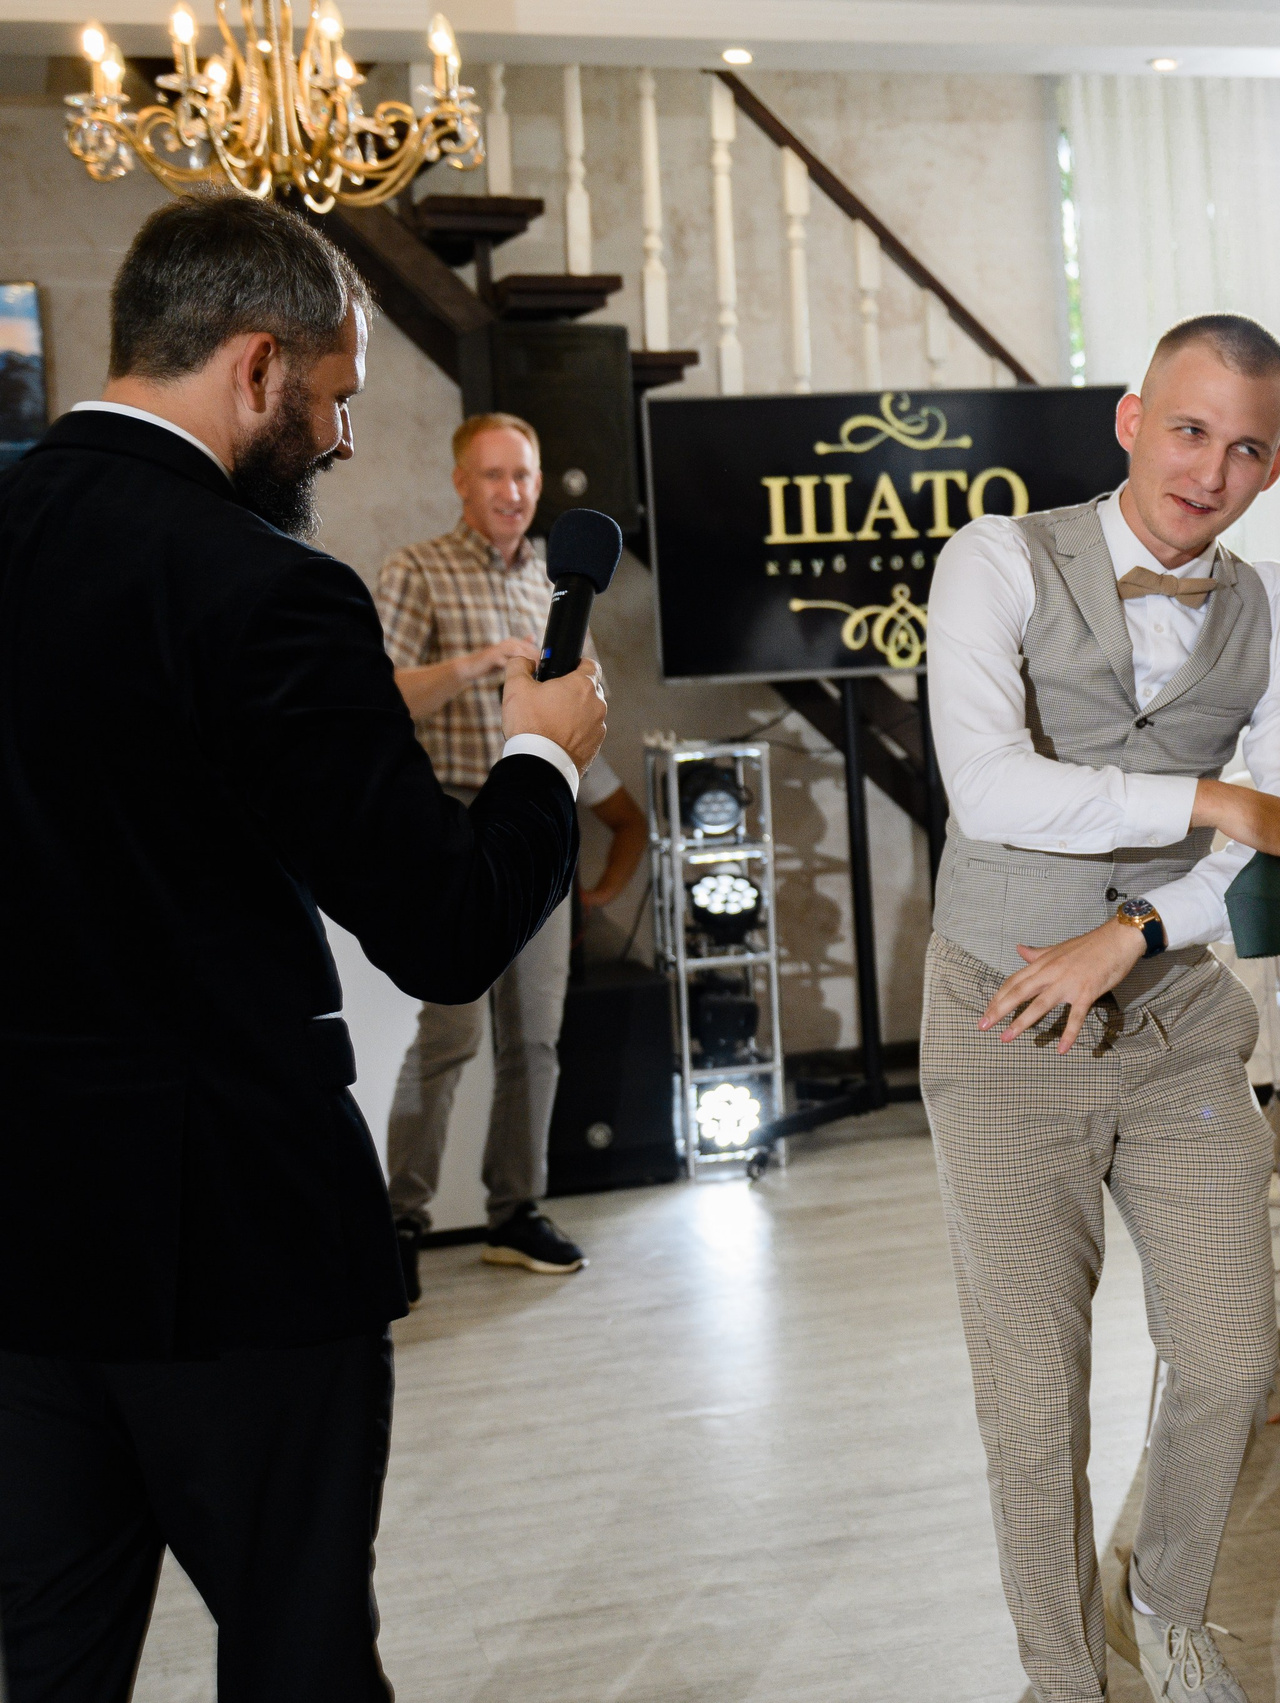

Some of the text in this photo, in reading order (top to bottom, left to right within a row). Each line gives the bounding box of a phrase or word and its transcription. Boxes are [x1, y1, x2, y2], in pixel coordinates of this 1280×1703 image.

[761, 467, 1029, 544] ШАТО
[765, 551, 940, 578] клуб соб
